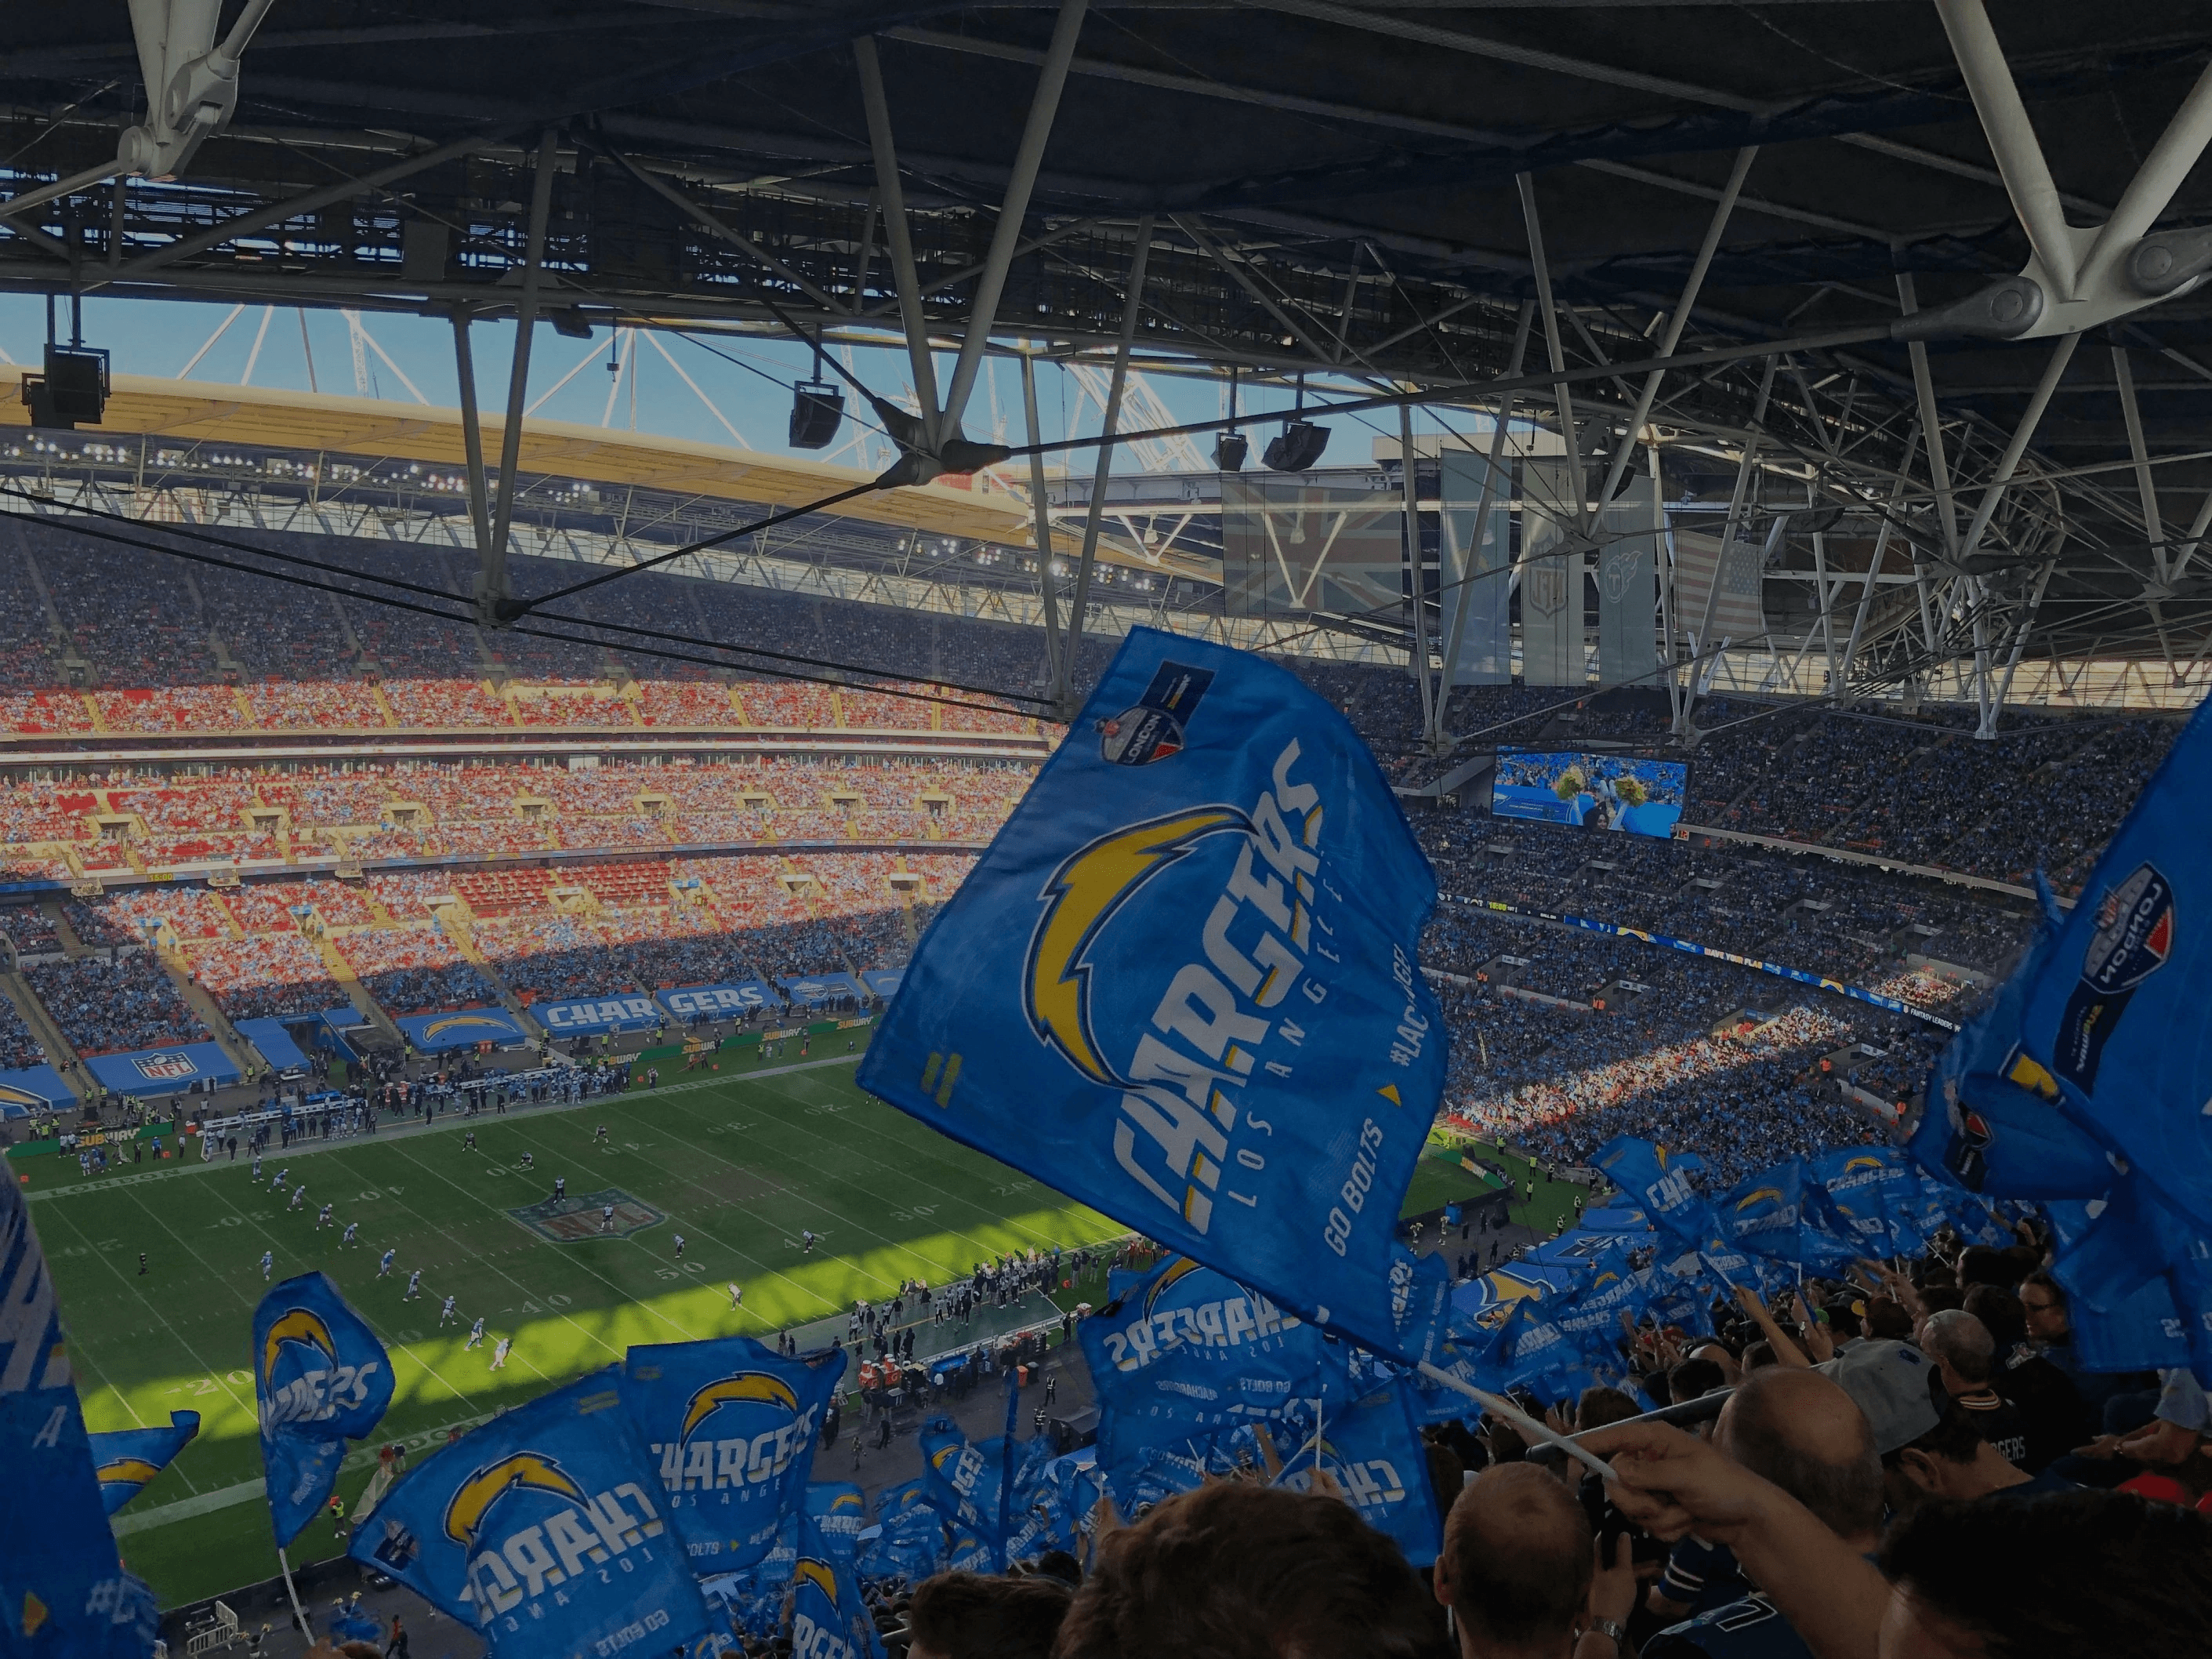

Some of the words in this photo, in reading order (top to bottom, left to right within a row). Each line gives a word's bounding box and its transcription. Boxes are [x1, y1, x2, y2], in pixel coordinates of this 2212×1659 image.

[1123, 714, 1162, 763] LONDON
[1113, 737, 1323, 1236] CHARGERS
[546, 997, 658, 1027] CHAR
[669, 986, 763, 1013] GERS
[1910, 1007, 1932, 1022] FANTASY
[1932, 1015, 1953, 1029] LEADERS
[762, 1027, 803, 1041] SUBWAY
[836, 1016, 874, 1029] SUBWAY
[145, 1063, 191, 1078] NFL
[1227, 1109, 1274, 1208] LOS
[1323, 1225, 1352, 1258] GO
[1340, 1116, 1385, 1213] BOLTS
[653, 1261, 706, 1281] 50
